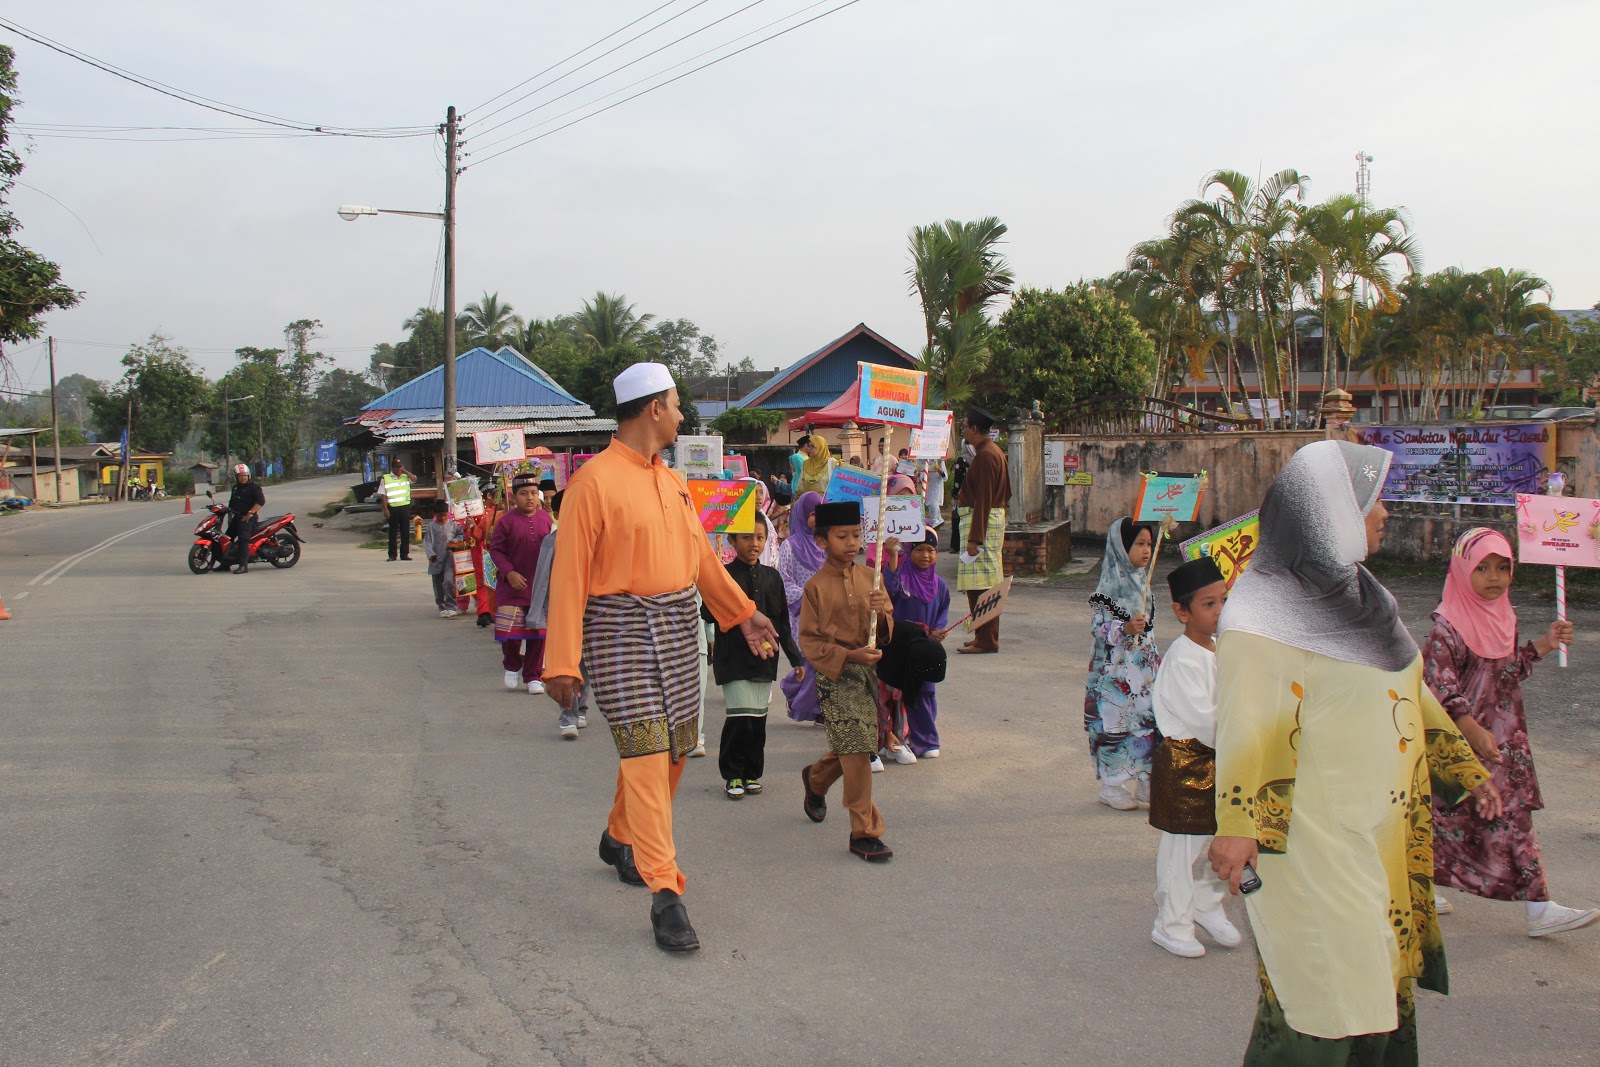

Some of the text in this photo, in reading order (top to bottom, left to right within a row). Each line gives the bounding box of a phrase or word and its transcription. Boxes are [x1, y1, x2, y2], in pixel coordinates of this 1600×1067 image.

[874, 389, 910, 403] MANUSIA
[877, 405, 906, 419] AGUNG
[1392, 429, 1446, 445] Sambutan
[1448, 429, 1500, 445] Maulidur
[1503, 427, 1549, 444] Rasul
[1405, 447, 1487, 456] PERINGKAT SEKOLAH
[887, 519, 921, 535] رسول
